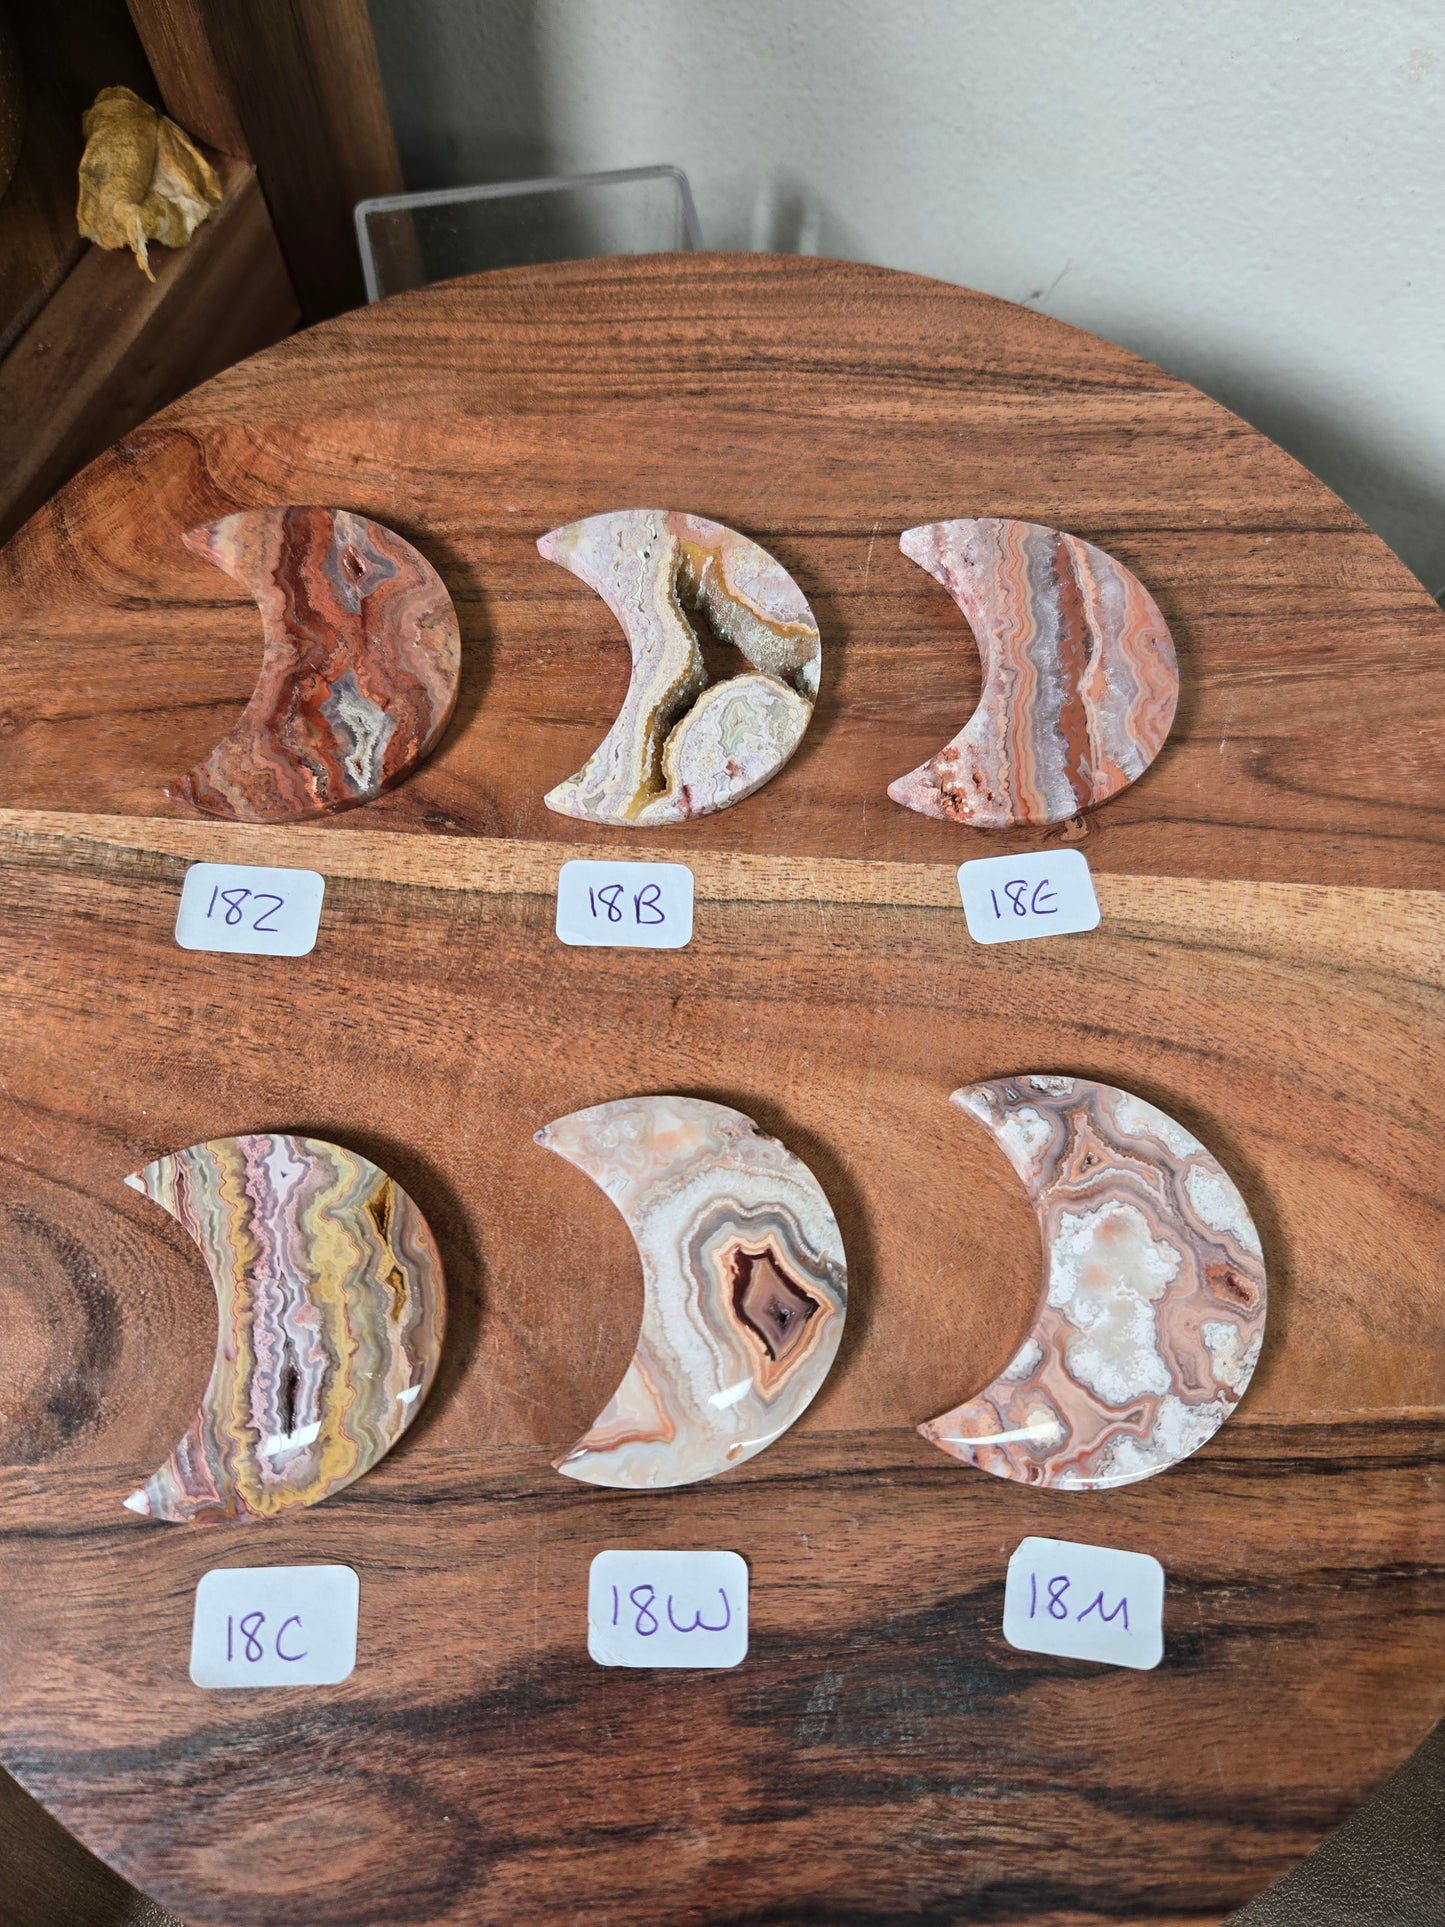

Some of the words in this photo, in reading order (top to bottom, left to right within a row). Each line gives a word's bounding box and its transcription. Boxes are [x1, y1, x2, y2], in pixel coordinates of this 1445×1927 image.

[588, 884, 665, 925] 18B
[989, 879, 1058, 919] 18E
[227, 1611, 307, 1663] 18C
